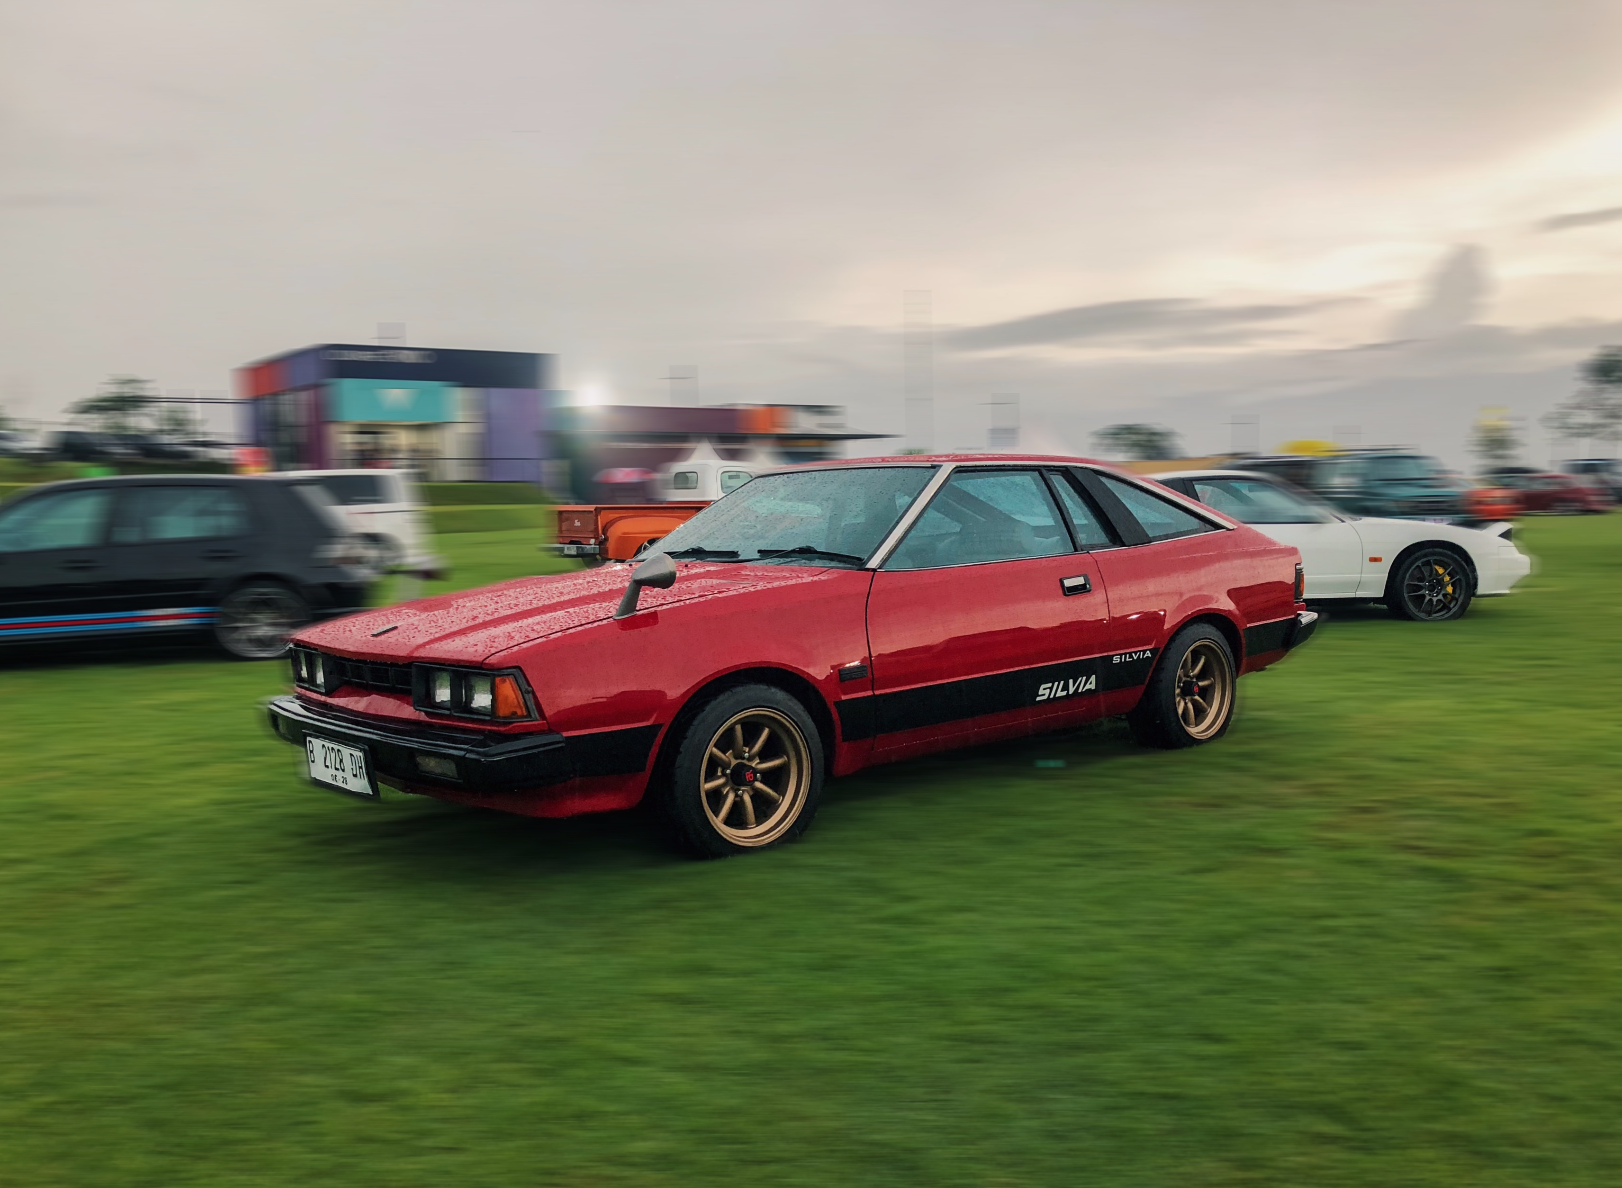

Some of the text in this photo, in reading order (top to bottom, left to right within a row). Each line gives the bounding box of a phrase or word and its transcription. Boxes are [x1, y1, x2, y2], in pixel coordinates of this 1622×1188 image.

[1112, 650, 1152, 664] SILVIA
[1035, 674, 1096, 701] SILVIA
[308, 740, 365, 781] B 2128 DH
